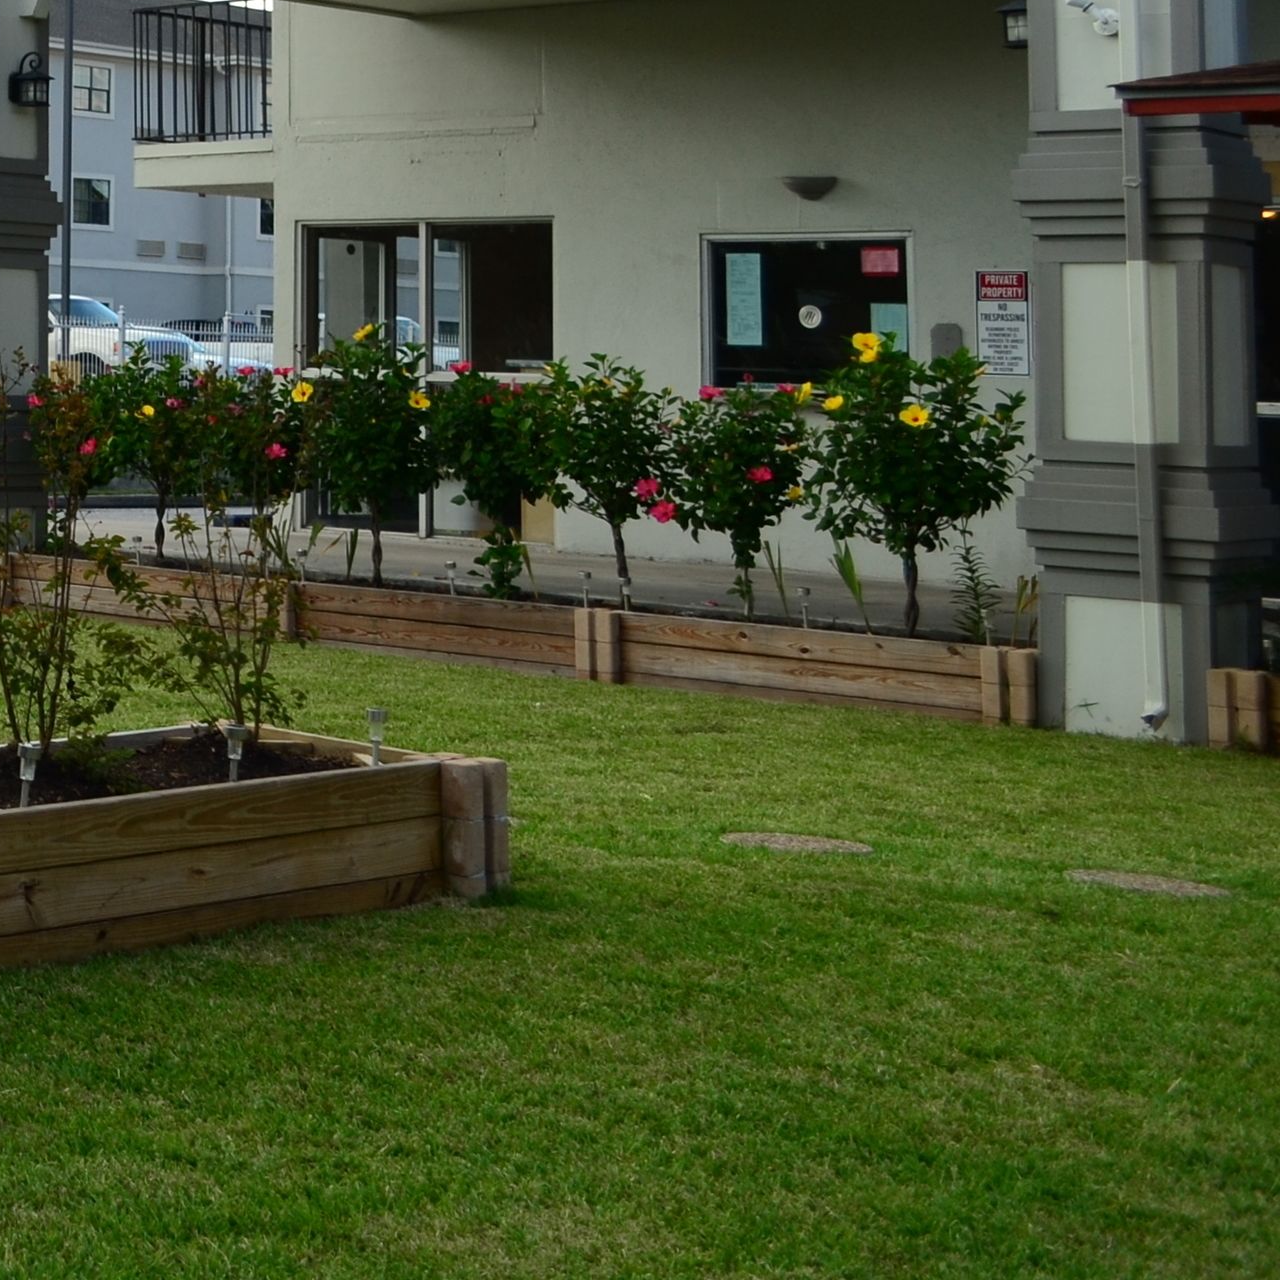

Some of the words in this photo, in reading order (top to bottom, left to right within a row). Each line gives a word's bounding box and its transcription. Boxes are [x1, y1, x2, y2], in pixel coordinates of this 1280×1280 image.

[985, 275, 1018, 285] PRIVATE
[981, 287, 1022, 297] PROPERTY
[998, 303, 1007, 311] NO
[980, 313, 1025, 322] TRESPASSING
